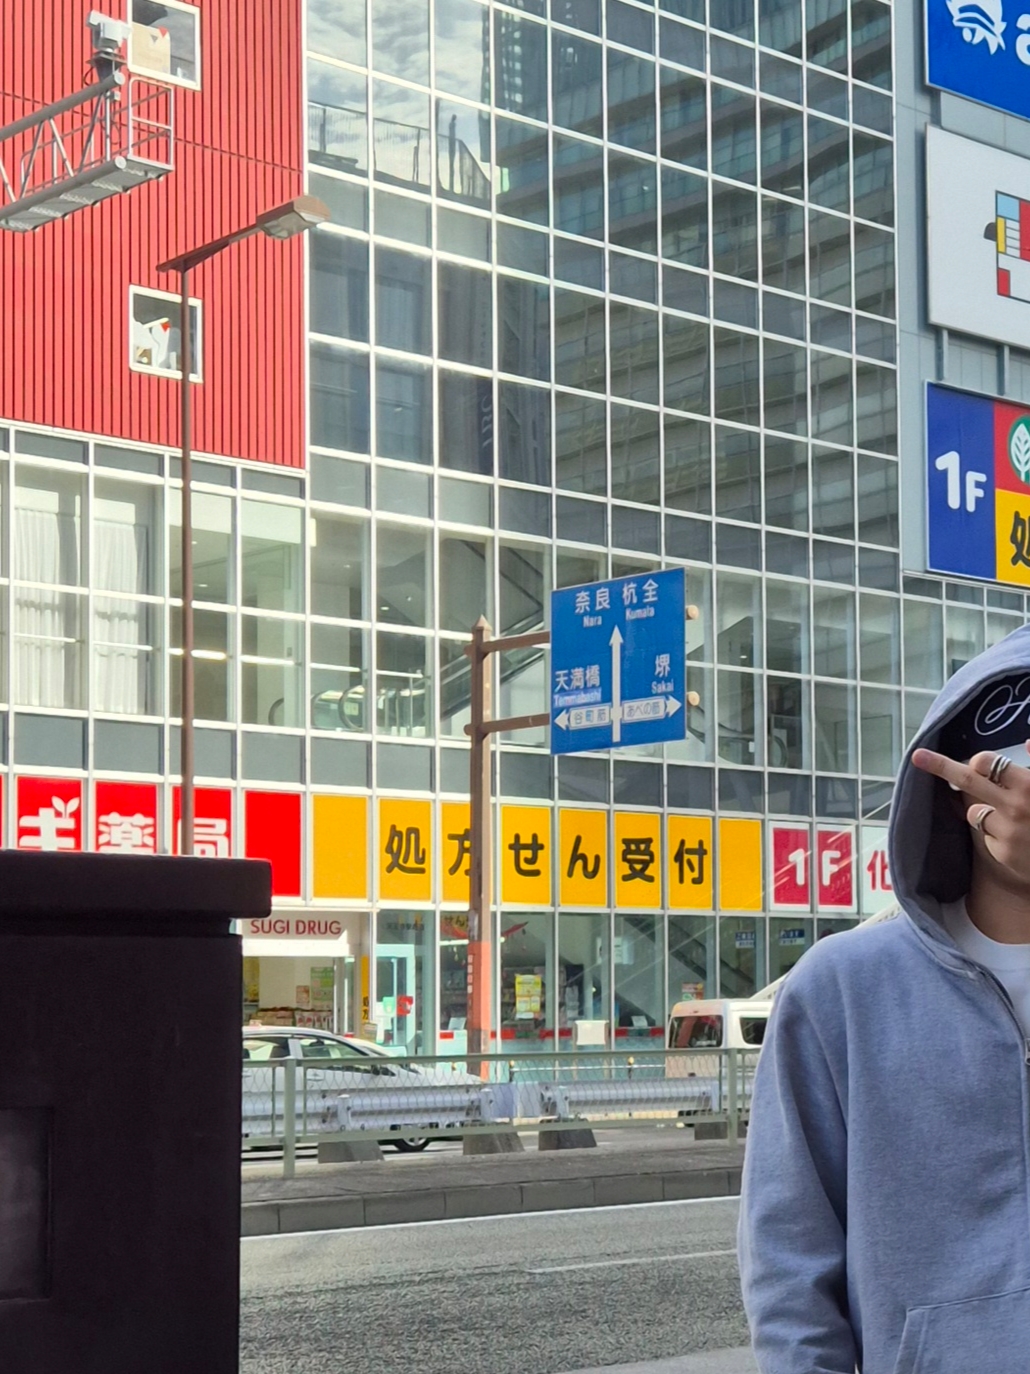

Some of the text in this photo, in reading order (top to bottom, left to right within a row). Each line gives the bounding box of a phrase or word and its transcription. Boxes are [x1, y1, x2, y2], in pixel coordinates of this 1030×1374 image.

[934, 451, 988, 513] 1F
[575, 578, 659, 614] 奈良 杭全
[583, 615, 602, 628] Nara
[625, 605, 654, 621] Kumata
[655, 653, 670, 678] 堺
[554, 665, 600, 692] 天満橋
[652, 679, 674, 694] Sakai
[788, 848, 841, 887] 1F
[250, 919, 342, 935] SUGI DRUG
